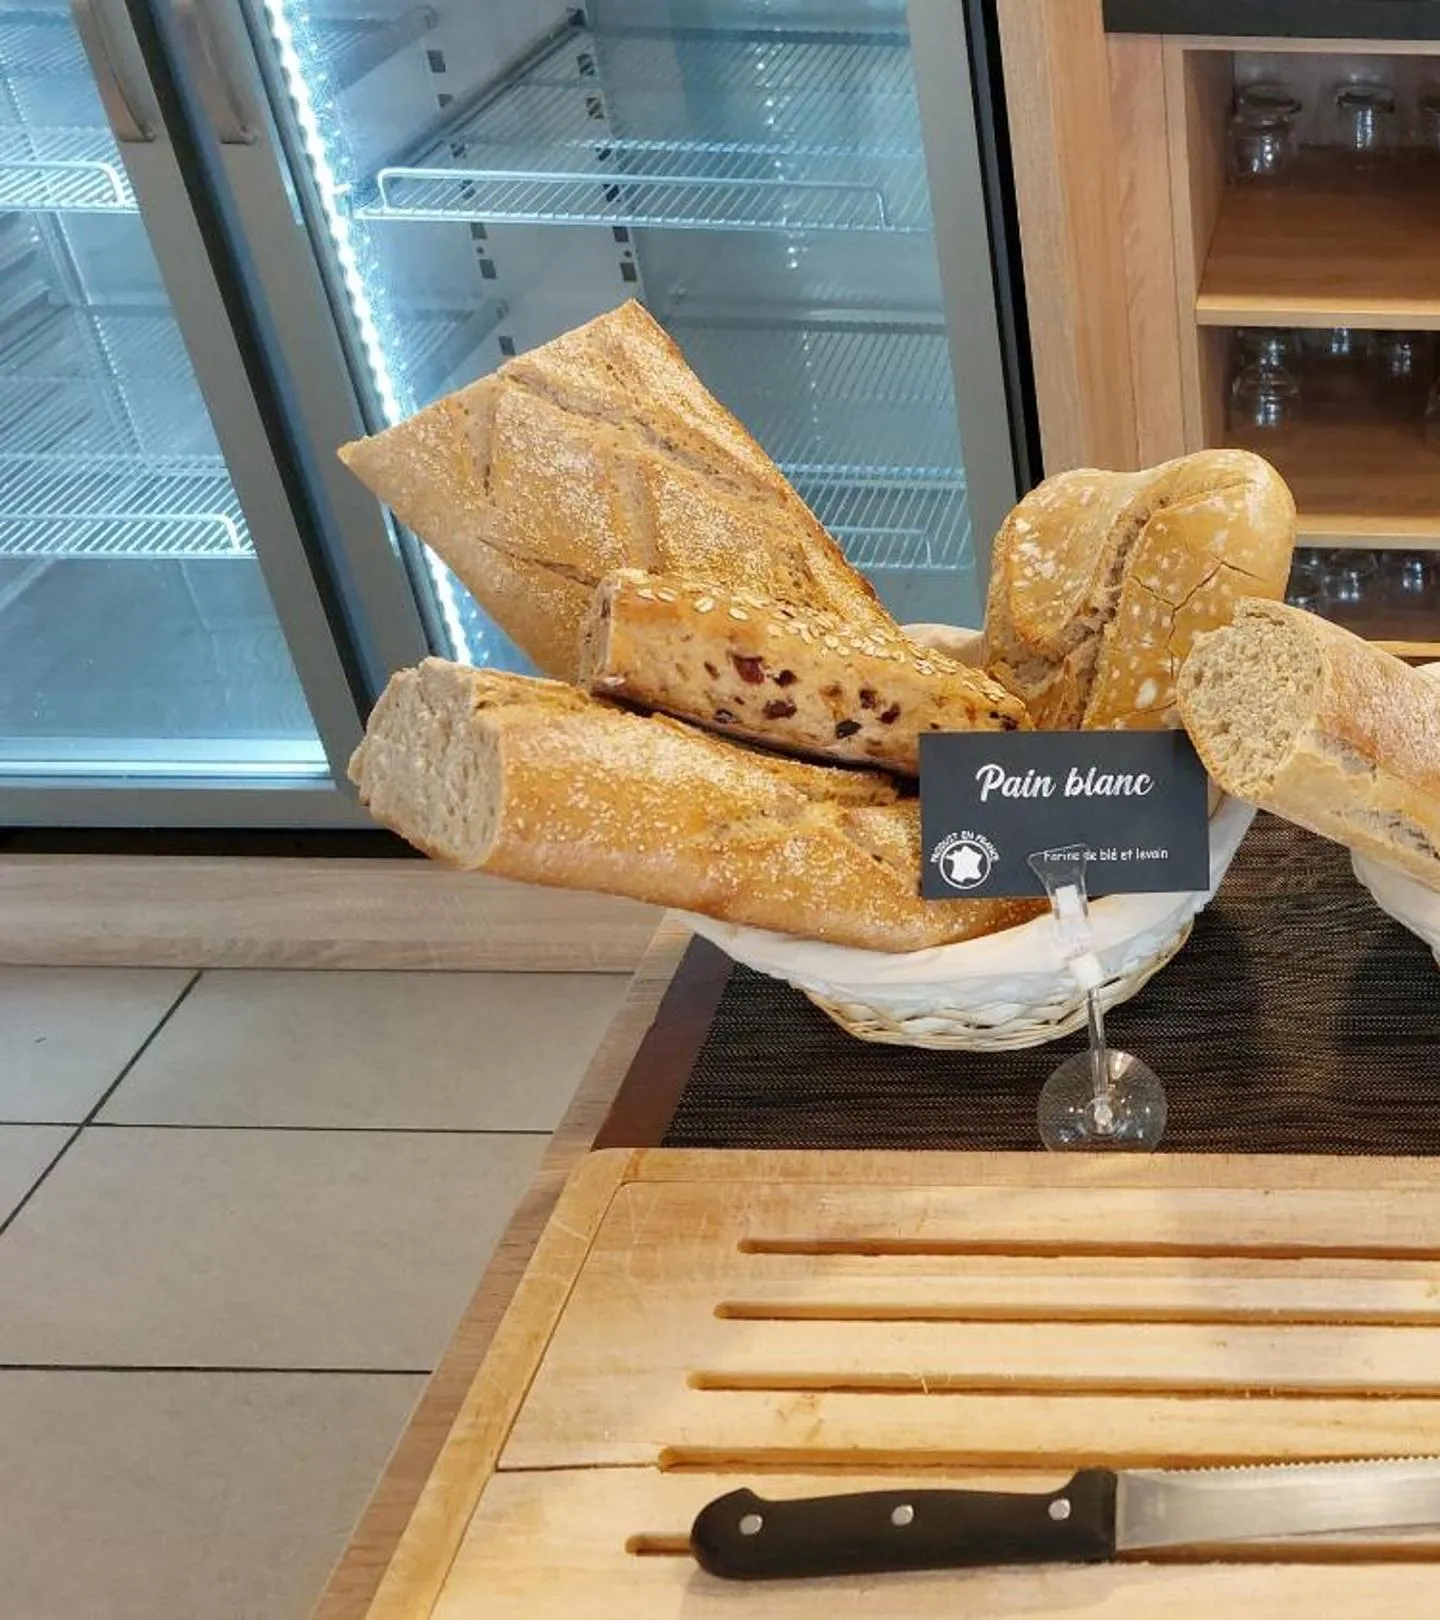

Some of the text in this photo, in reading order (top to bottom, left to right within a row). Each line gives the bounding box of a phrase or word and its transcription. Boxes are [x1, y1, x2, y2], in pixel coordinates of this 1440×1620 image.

[975, 763, 1155, 802] Pain blanc
[1099, 847, 1117, 862] blé
[1120, 848, 1134, 862] et
[1135, 846, 1169, 861] levain
